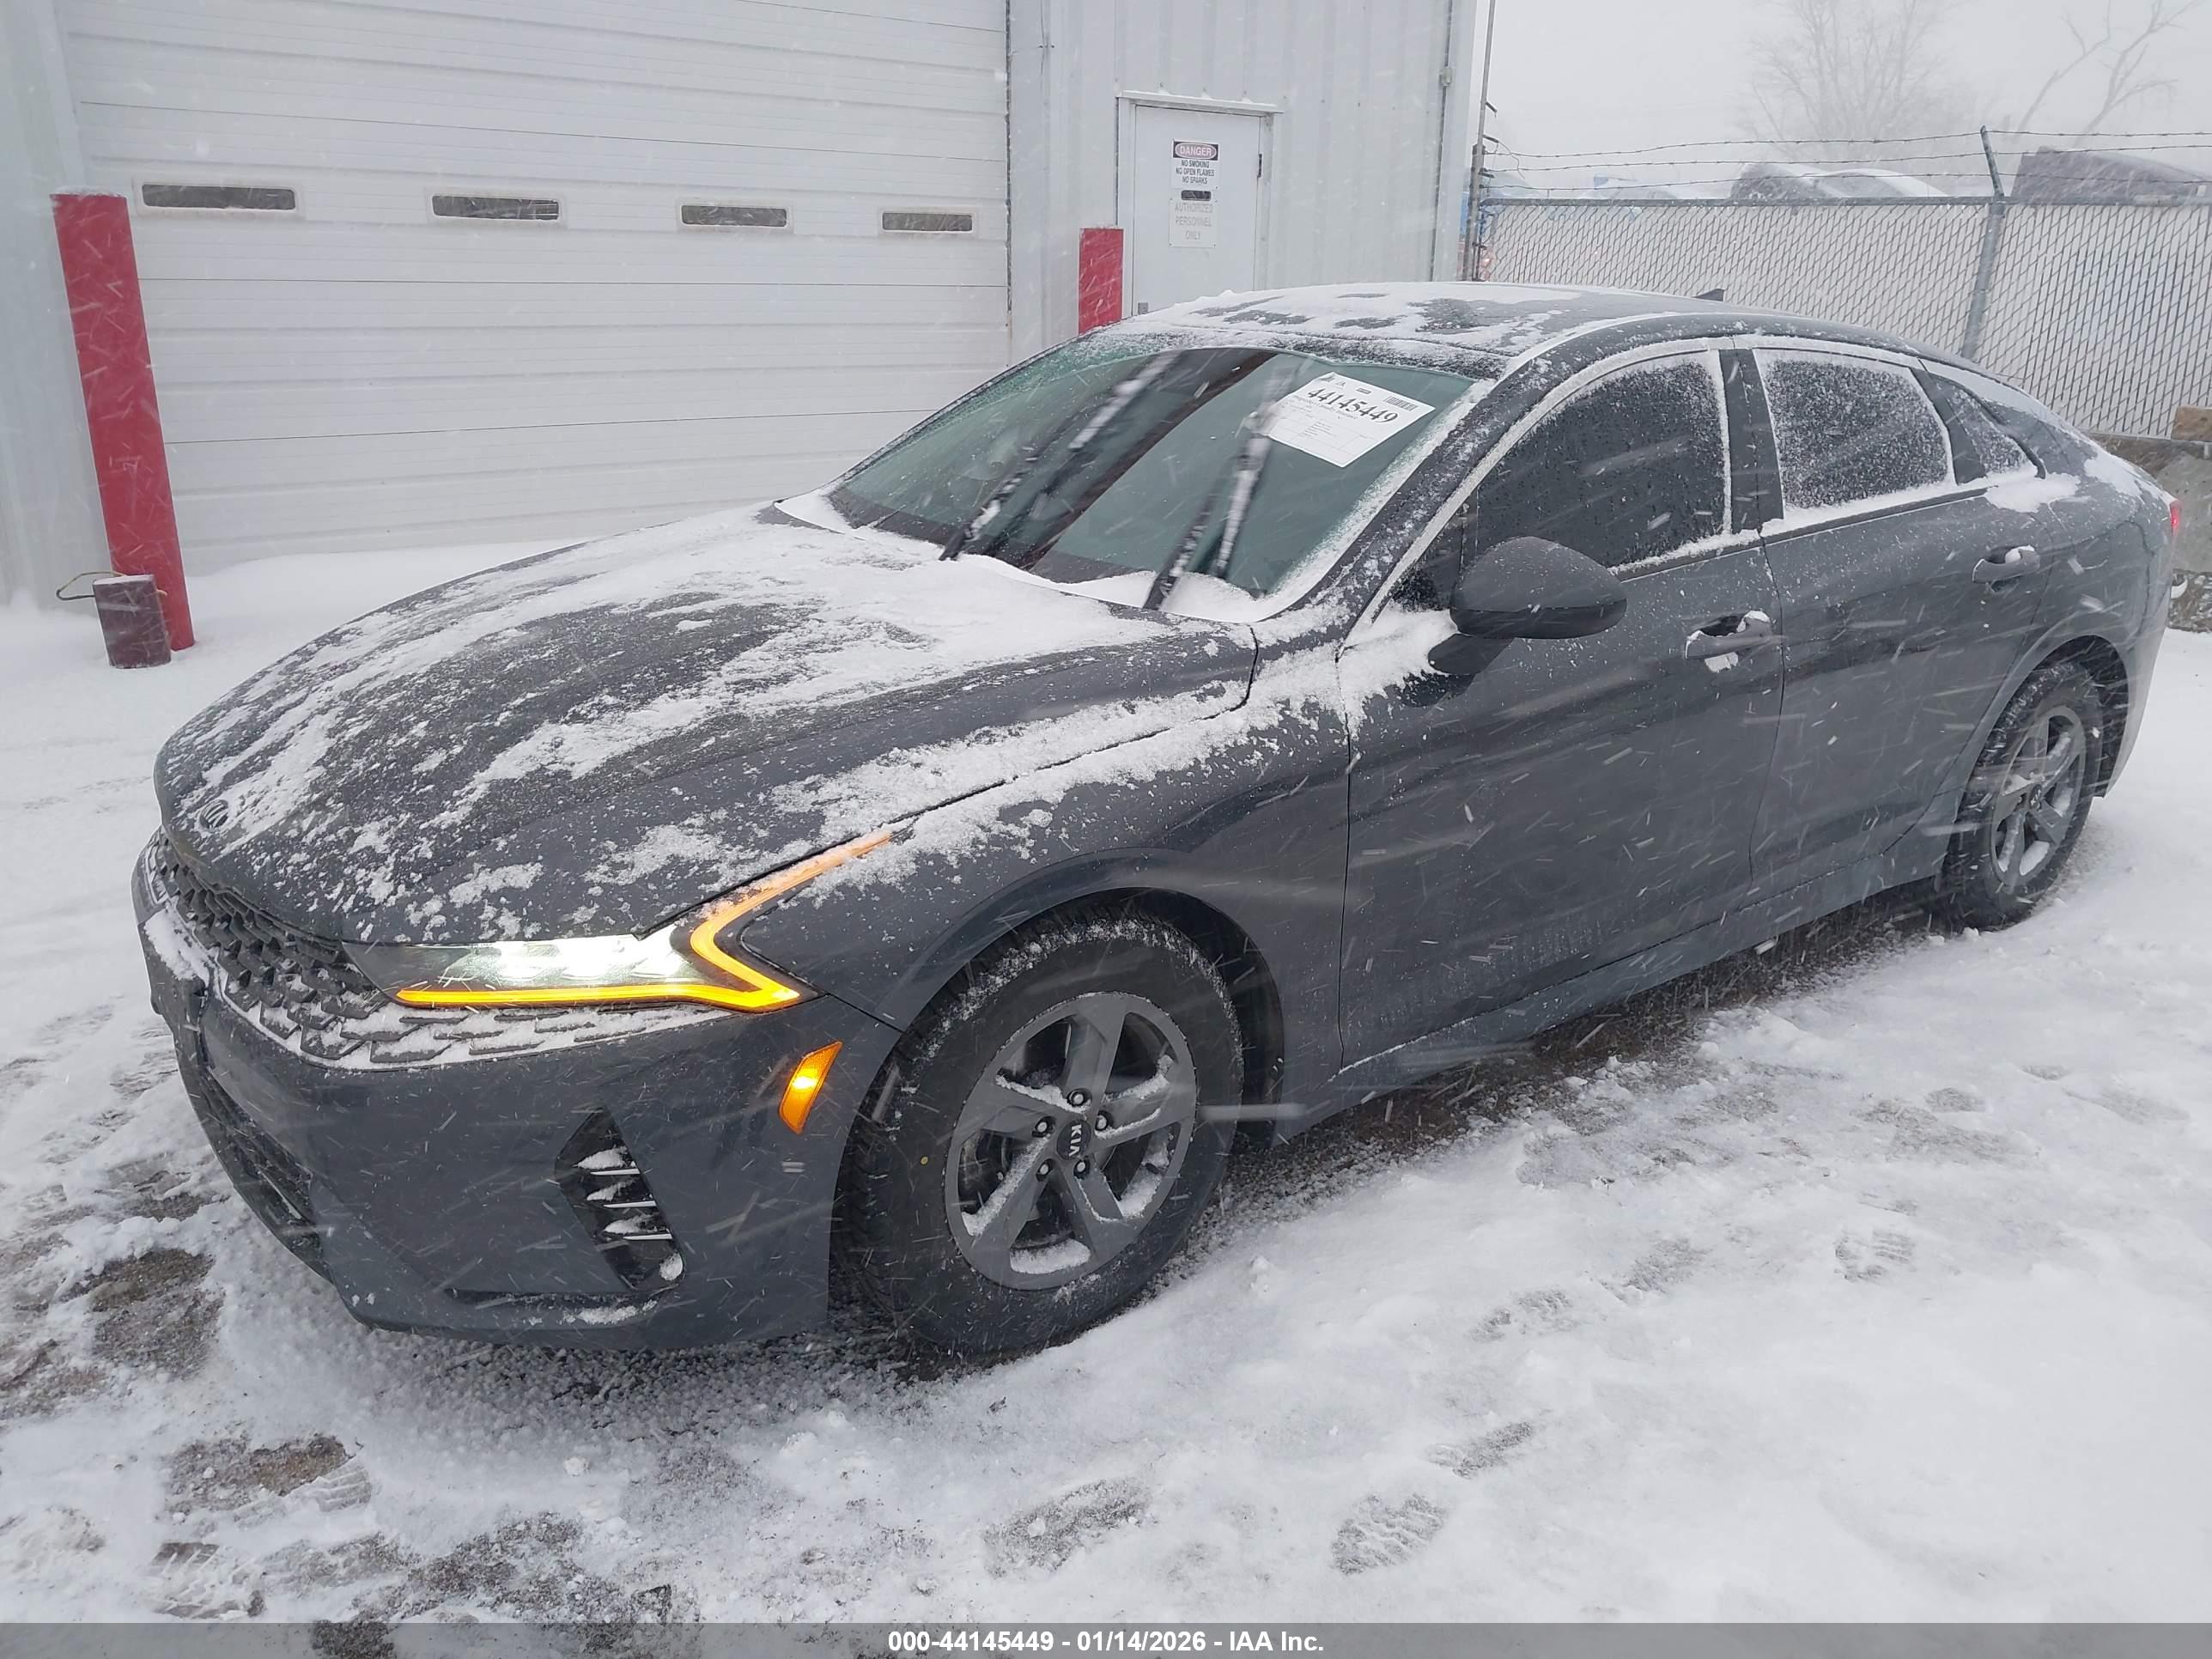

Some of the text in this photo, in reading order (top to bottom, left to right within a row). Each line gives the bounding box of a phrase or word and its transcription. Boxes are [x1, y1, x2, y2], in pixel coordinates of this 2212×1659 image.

[1180, 145, 1212, 156] DANGER
[1175, 203, 1213, 214] AUTHORIZED
[1176, 216, 1212, 227] PERSONNEL
[1307, 388, 1399, 423] 44145449
[1068, 1124, 1082, 1158] KIA
